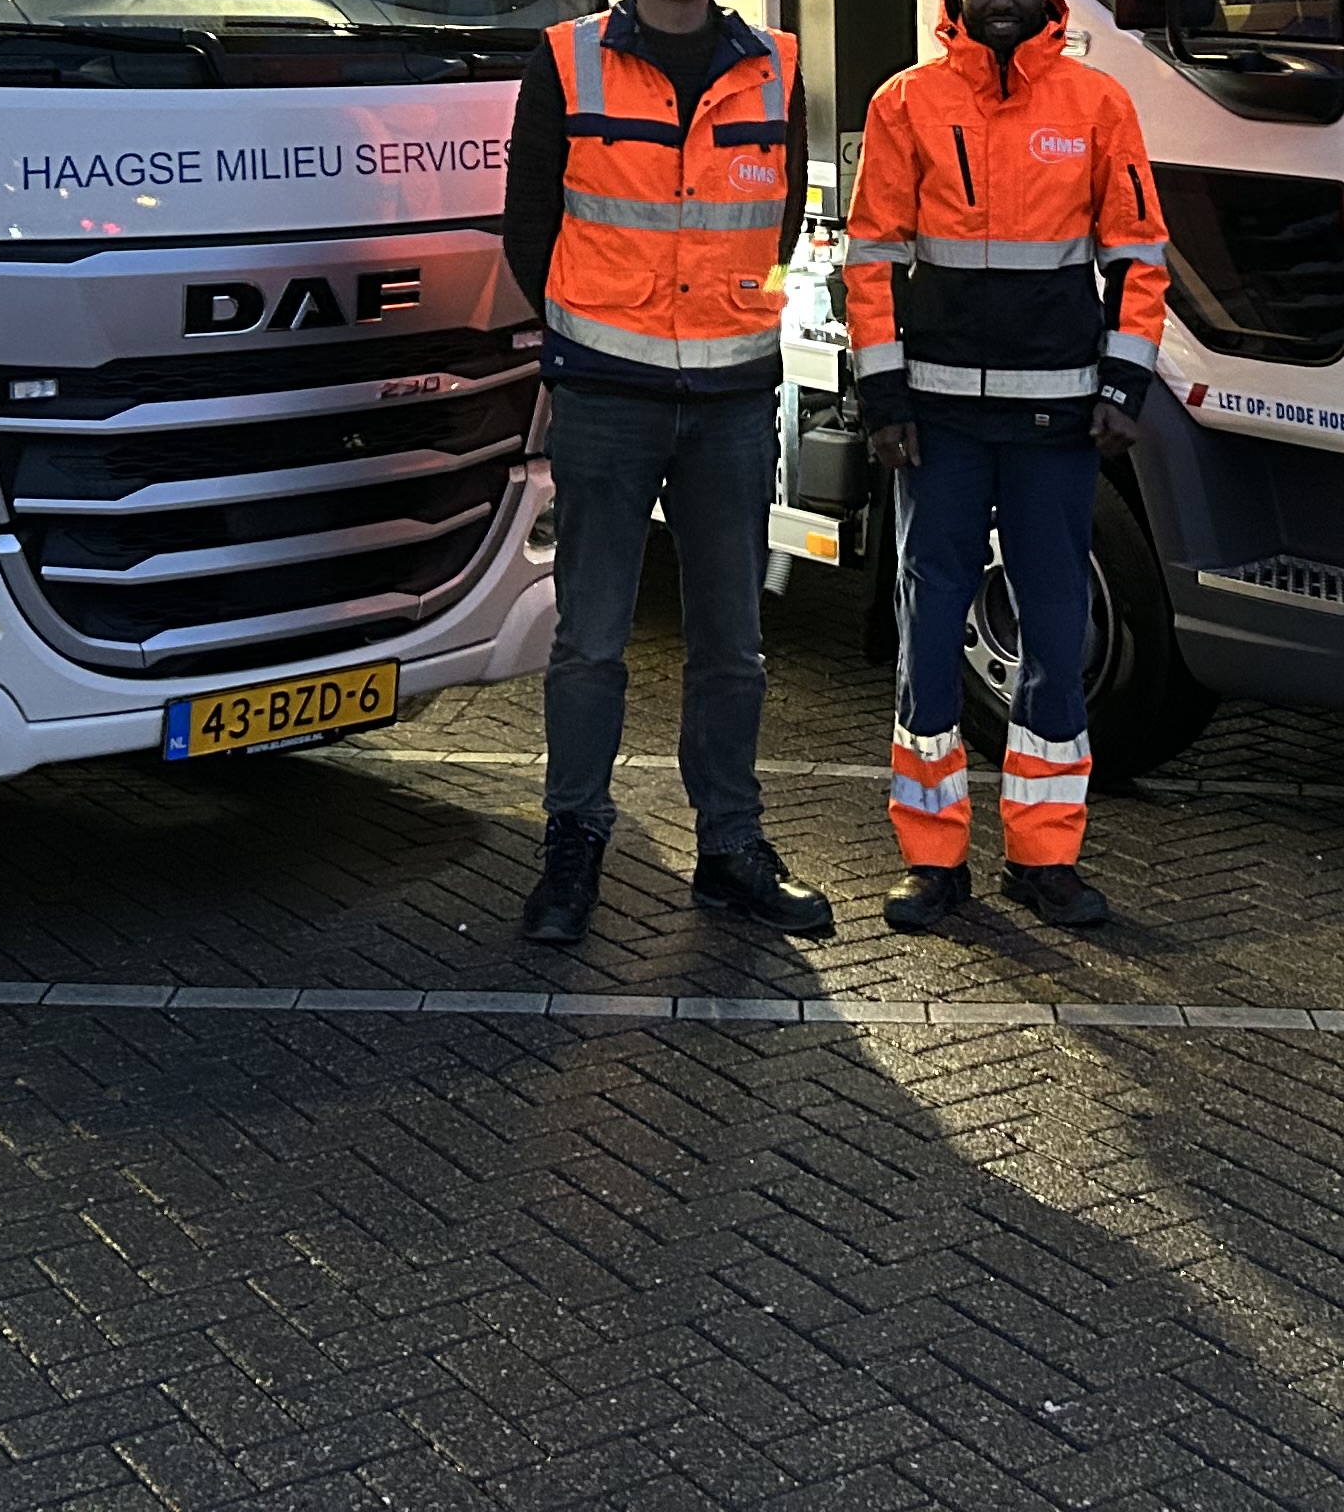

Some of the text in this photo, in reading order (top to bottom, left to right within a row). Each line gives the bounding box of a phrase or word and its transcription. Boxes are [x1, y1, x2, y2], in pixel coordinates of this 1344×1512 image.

[1040, 135, 1086, 153] HMS
[22, 150, 203, 190] HAAGSE
[216, 145, 344, 182] MILIEU
[738, 162, 777, 184] HMS
[182, 267, 422, 339] DAF
[1218, 392, 1242, 412] LET
[1247, 399, 1271, 418] OP:
[1275, 402, 1314, 425] DODE
[201, 673, 381, 743] 43-BZD-6
[169, 737, 187, 750] NL
